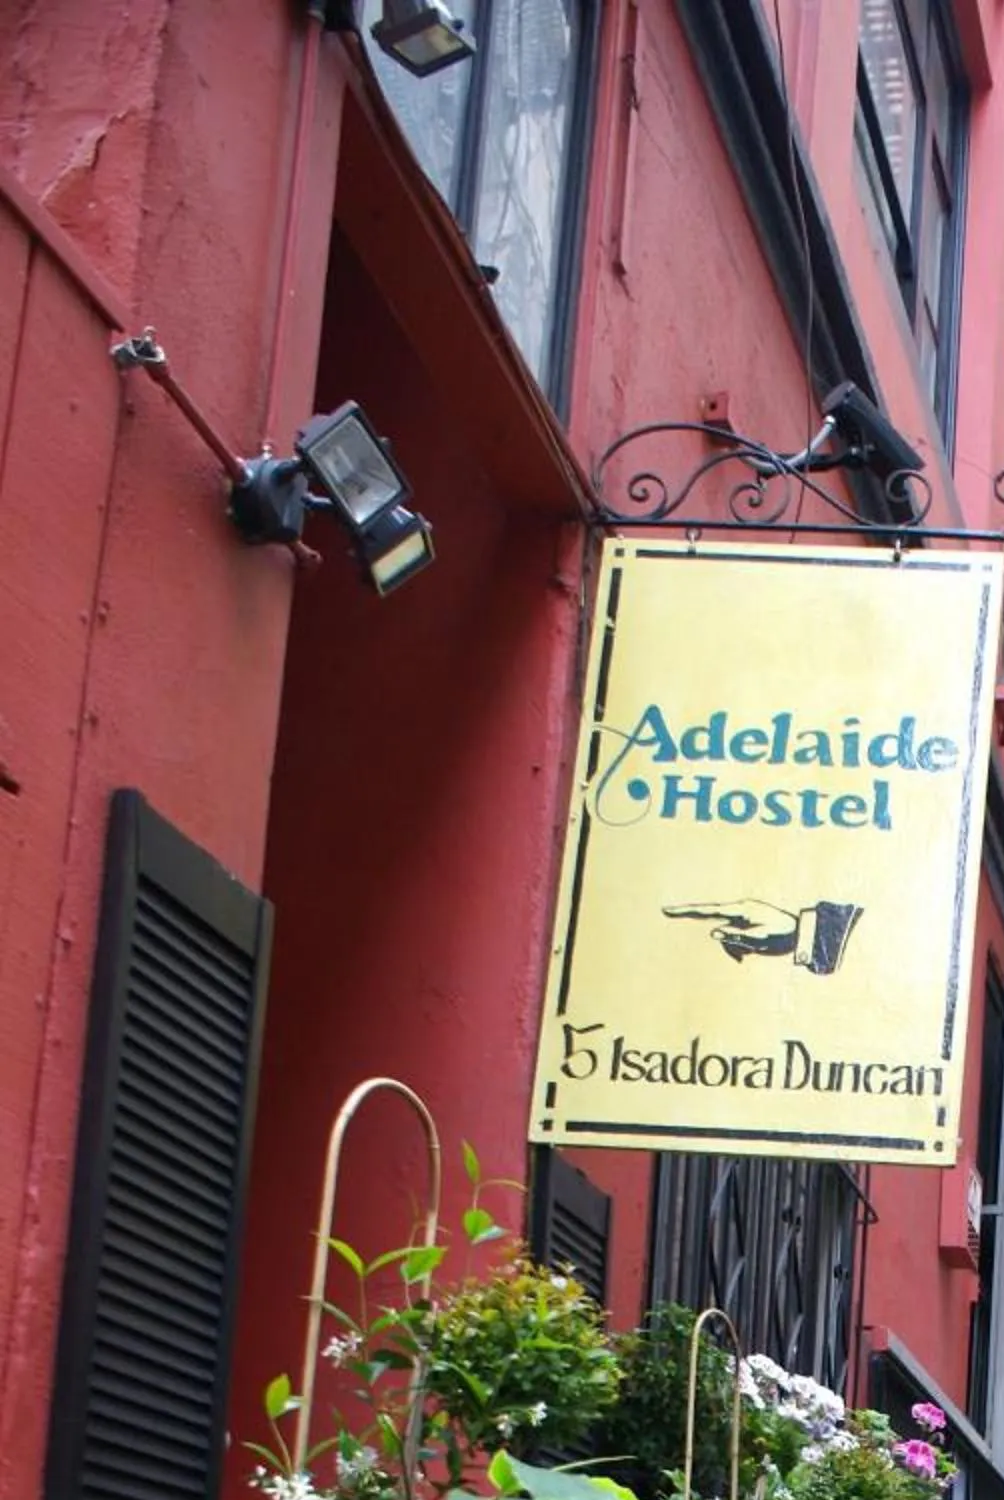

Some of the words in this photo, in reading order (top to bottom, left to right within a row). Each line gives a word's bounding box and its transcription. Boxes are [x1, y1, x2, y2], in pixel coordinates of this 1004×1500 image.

[658, 774, 893, 831] Hostel
[560, 1022, 605, 1080] 5
[609, 1035, 774, 1090] Isadora
[782, 1038, 944, 1097] Duncan
